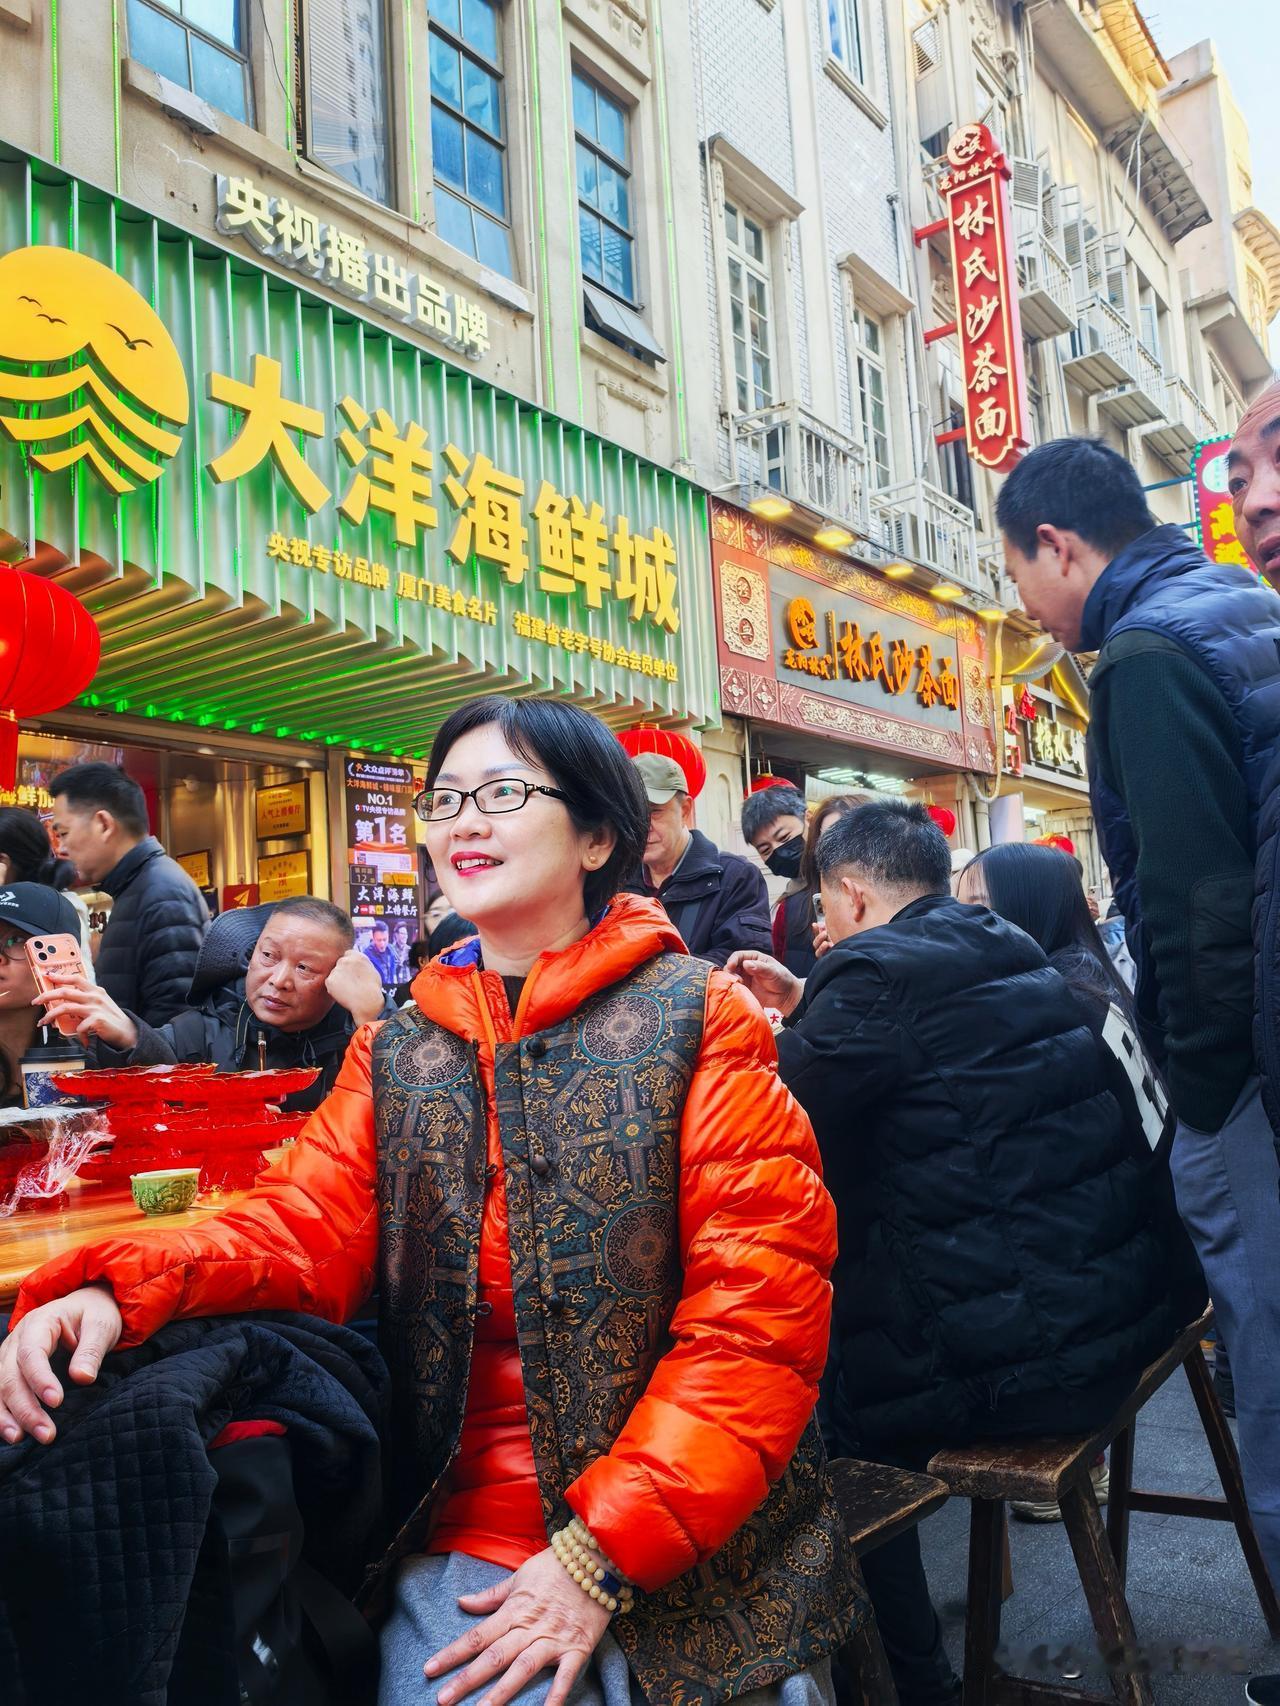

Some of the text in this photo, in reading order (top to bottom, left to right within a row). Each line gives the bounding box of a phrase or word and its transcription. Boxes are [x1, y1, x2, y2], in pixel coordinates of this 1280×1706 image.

[222, 176, 490, 354] 央视播出品牌
[954, 195, 1007, 440] 林氏沙茶面
[206, 353, 680, 634] 大洋海鲜城
[267, 532, 679, 683] 央视专访品牌 厦门美食名片 福建省老字号协会会员单位
[838, 620, 959, 711] 林氏沙茶面
[355, 816, 407, 846] 第1名
[367, 793, 393, 806] NO.1
[357, 885, 415, 904] 大洋海鲜
